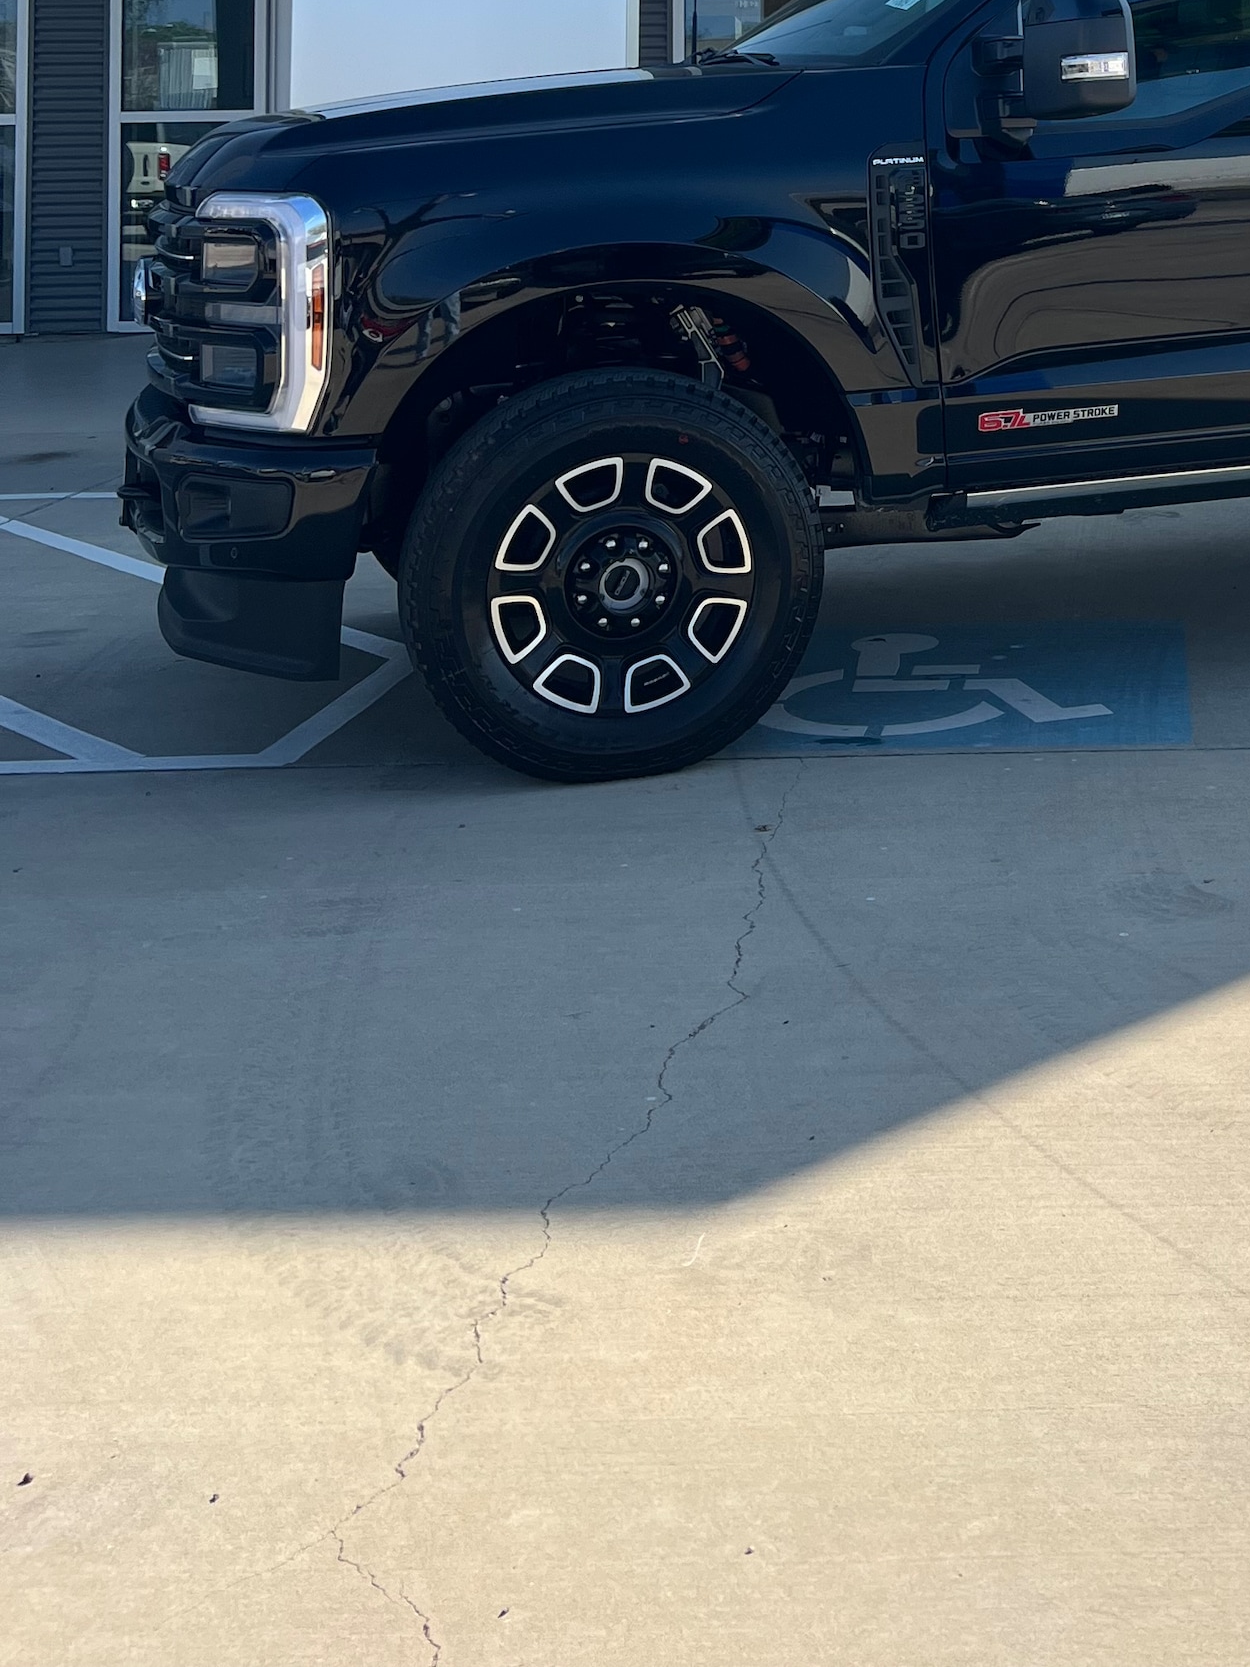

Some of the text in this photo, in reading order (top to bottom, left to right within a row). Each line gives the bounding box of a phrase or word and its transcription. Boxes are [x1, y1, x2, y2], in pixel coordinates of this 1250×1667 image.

[872, 156, 924, 165] PLATINUM
[979, 408, 1031, 432] 6.7L
[1032, 411, 1070, 423] POWER
[1072, 406, 1115, 419] STROKE
